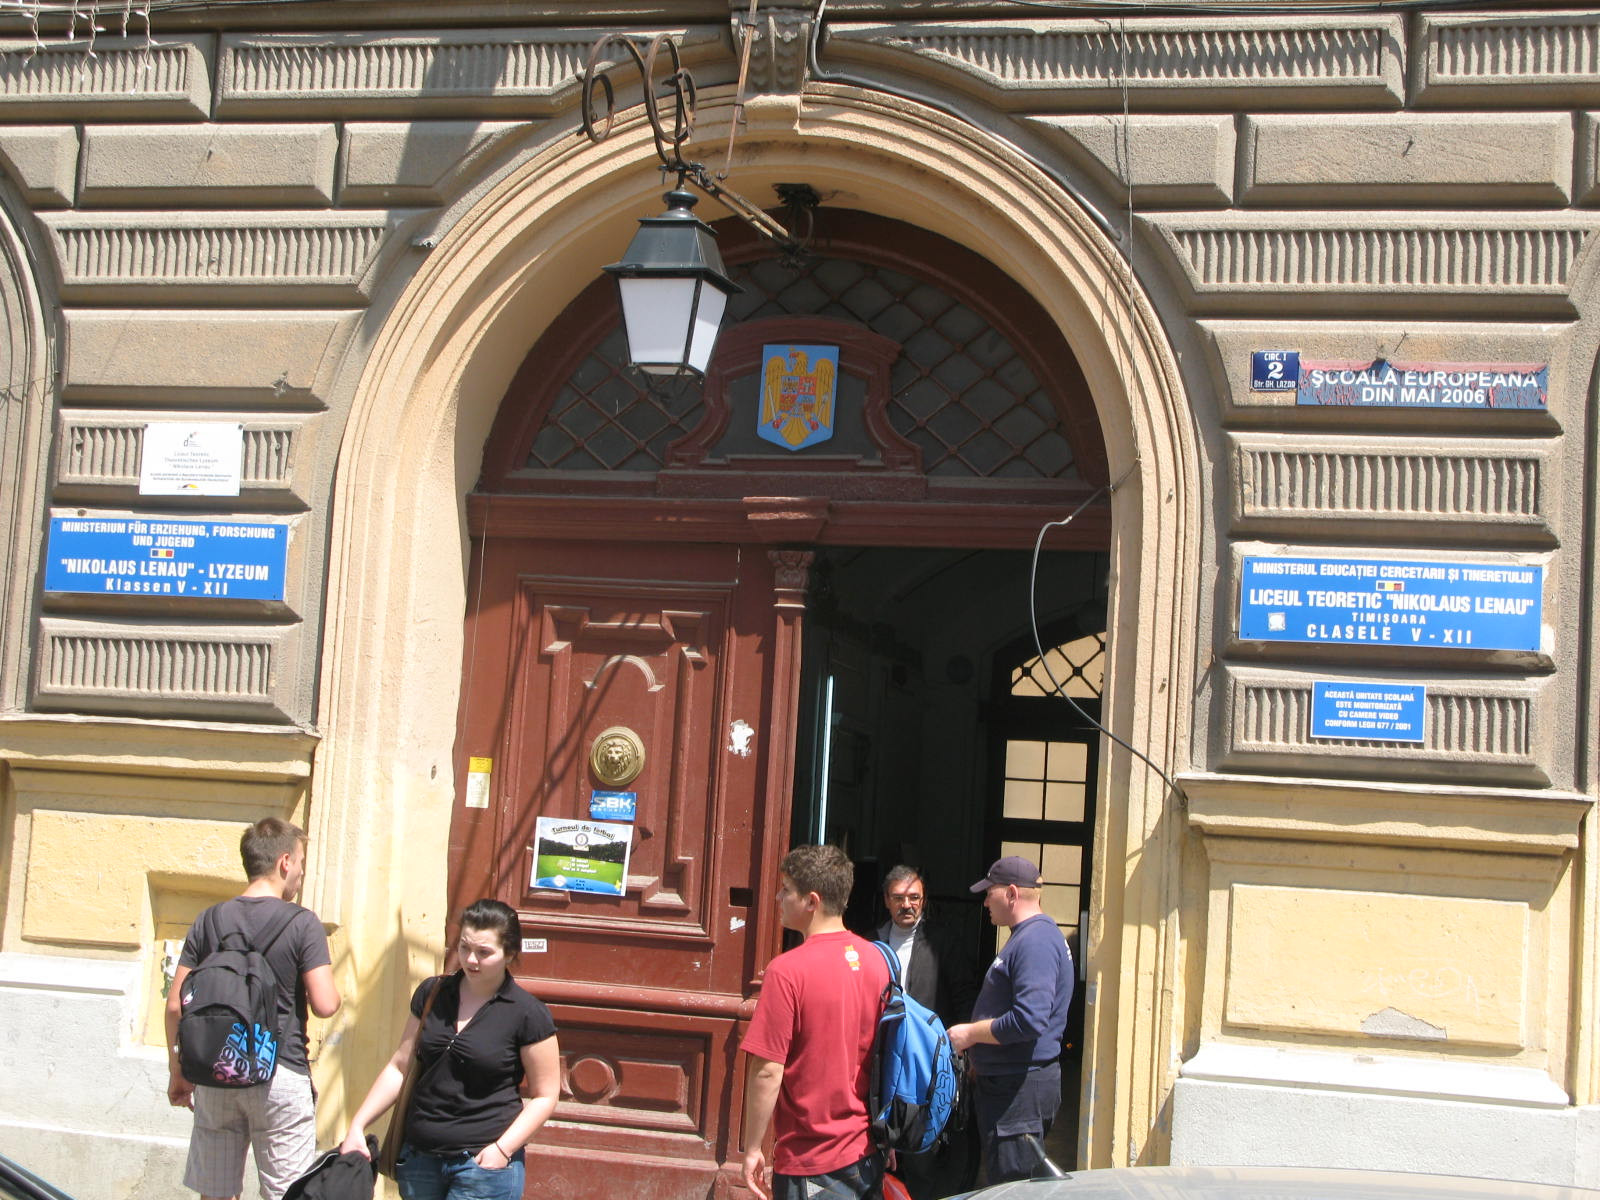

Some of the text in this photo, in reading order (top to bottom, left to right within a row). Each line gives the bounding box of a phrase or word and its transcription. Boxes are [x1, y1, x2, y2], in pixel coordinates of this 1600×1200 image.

[1267, 362, 1284, 379] 2
[1362, 387, 1485, 404] DIN MAI 2006
[61, 521, 275, 539] MINISTERIUM FÜR ERZIEHUNG, FORSCHUNG
[133, 536, 195, 548] UND JUGEND
[61, 559, 136, 576] "NIKOLAUS
[140, 561, 195, 578] LENAU"
[208, 564, 269, 581] LYZEUM
[1252, 562, 1317, 575] MINISTERUL
[1380, 566, 1445, 580] CERCETARII
[1462, 569, 1533, 584] TINERETULUI
[106, 578, 171, 593] Klassen
[177, 581, 187, 594] V
[204, 582, 228, 595] XII
[1250, 588, 1534, 615] LICEUL TEORETIC "NIKOLAUS LENAU"
[1307, 624, 1392, 641] CLASELE
[1411, 628, 1422, 642] V
[1443, 629, 1472, 644] XII
[1356, 692, 1383, 700] UNITATE
[1338, 710, 1399, 720] CU CAMERE VIDEO
[1324, 720, 1357, 728] CONFORM
[594, 797, 633, 809] SBK
